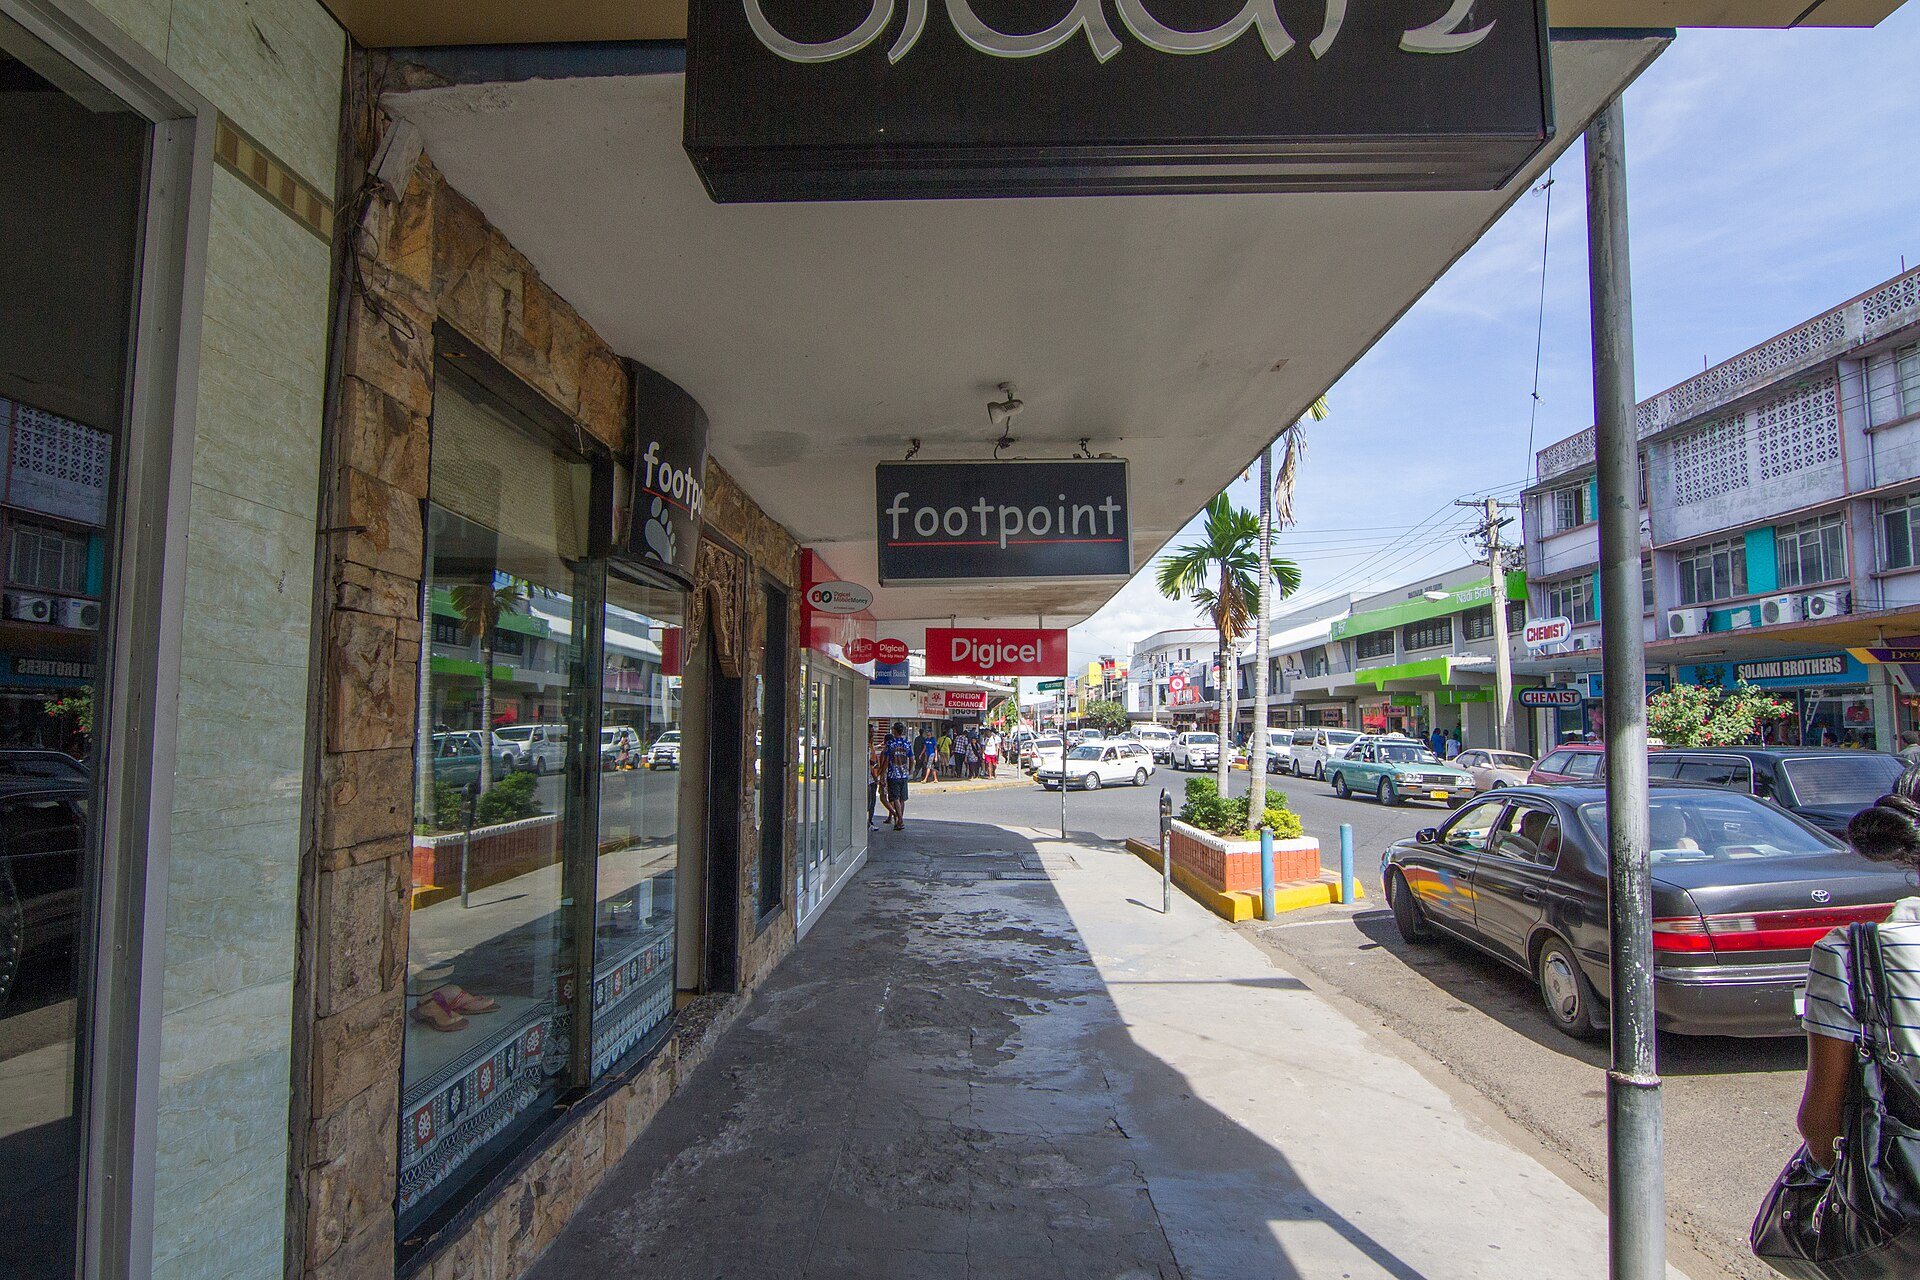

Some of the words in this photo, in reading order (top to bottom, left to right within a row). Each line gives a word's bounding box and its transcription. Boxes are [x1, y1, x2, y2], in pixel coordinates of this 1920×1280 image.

[885, 491, 1122, 550] footpoint
[1526, 623, 1565, 642] CHEMIST
[879, 643, 905, 653] Digicel
[951, 637, 1042, 669] Digicel
[1738, 662, 1781, 680] SOLANKI
[1782, 656, 1842, 676] BROTHERS
[951, 692, 981, 700] FOREIGN
[1523, 692, 1578, 703] CHEMIST
[948, 700, 983, 708] EXCHANGE
